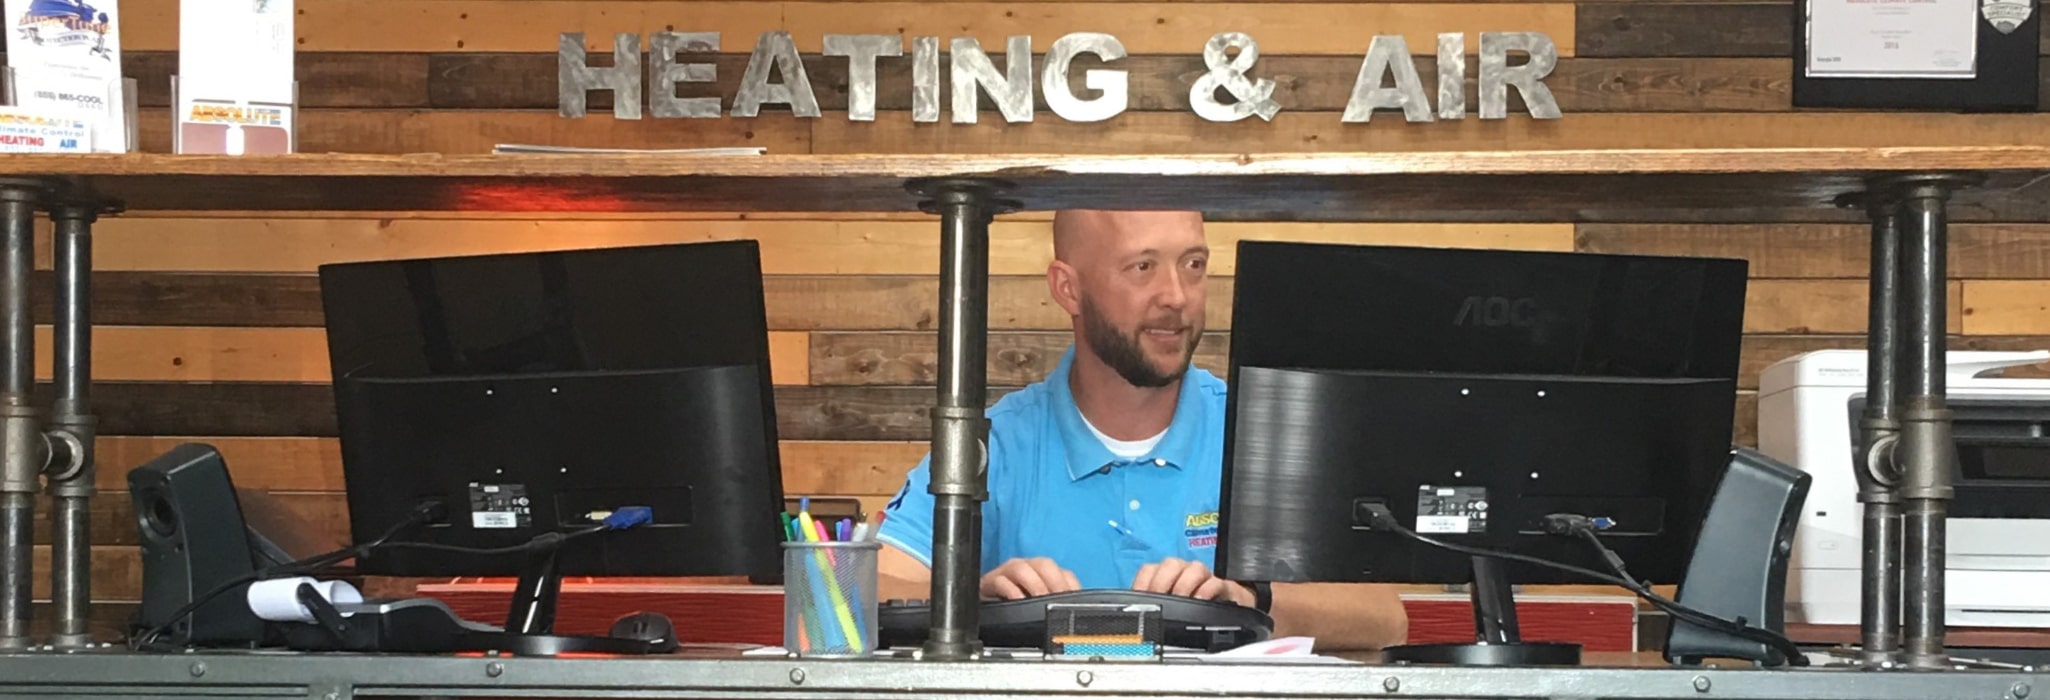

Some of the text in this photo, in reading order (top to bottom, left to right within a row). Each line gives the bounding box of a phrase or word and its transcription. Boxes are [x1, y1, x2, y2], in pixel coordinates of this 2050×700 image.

[558, 31, 1563, 123] HEATING & AIR
[190, 105, 281, 125] ABSOLUTE
[60, 138, 78, 148] AIR
[1452, 296, 1536, 327] AOC
